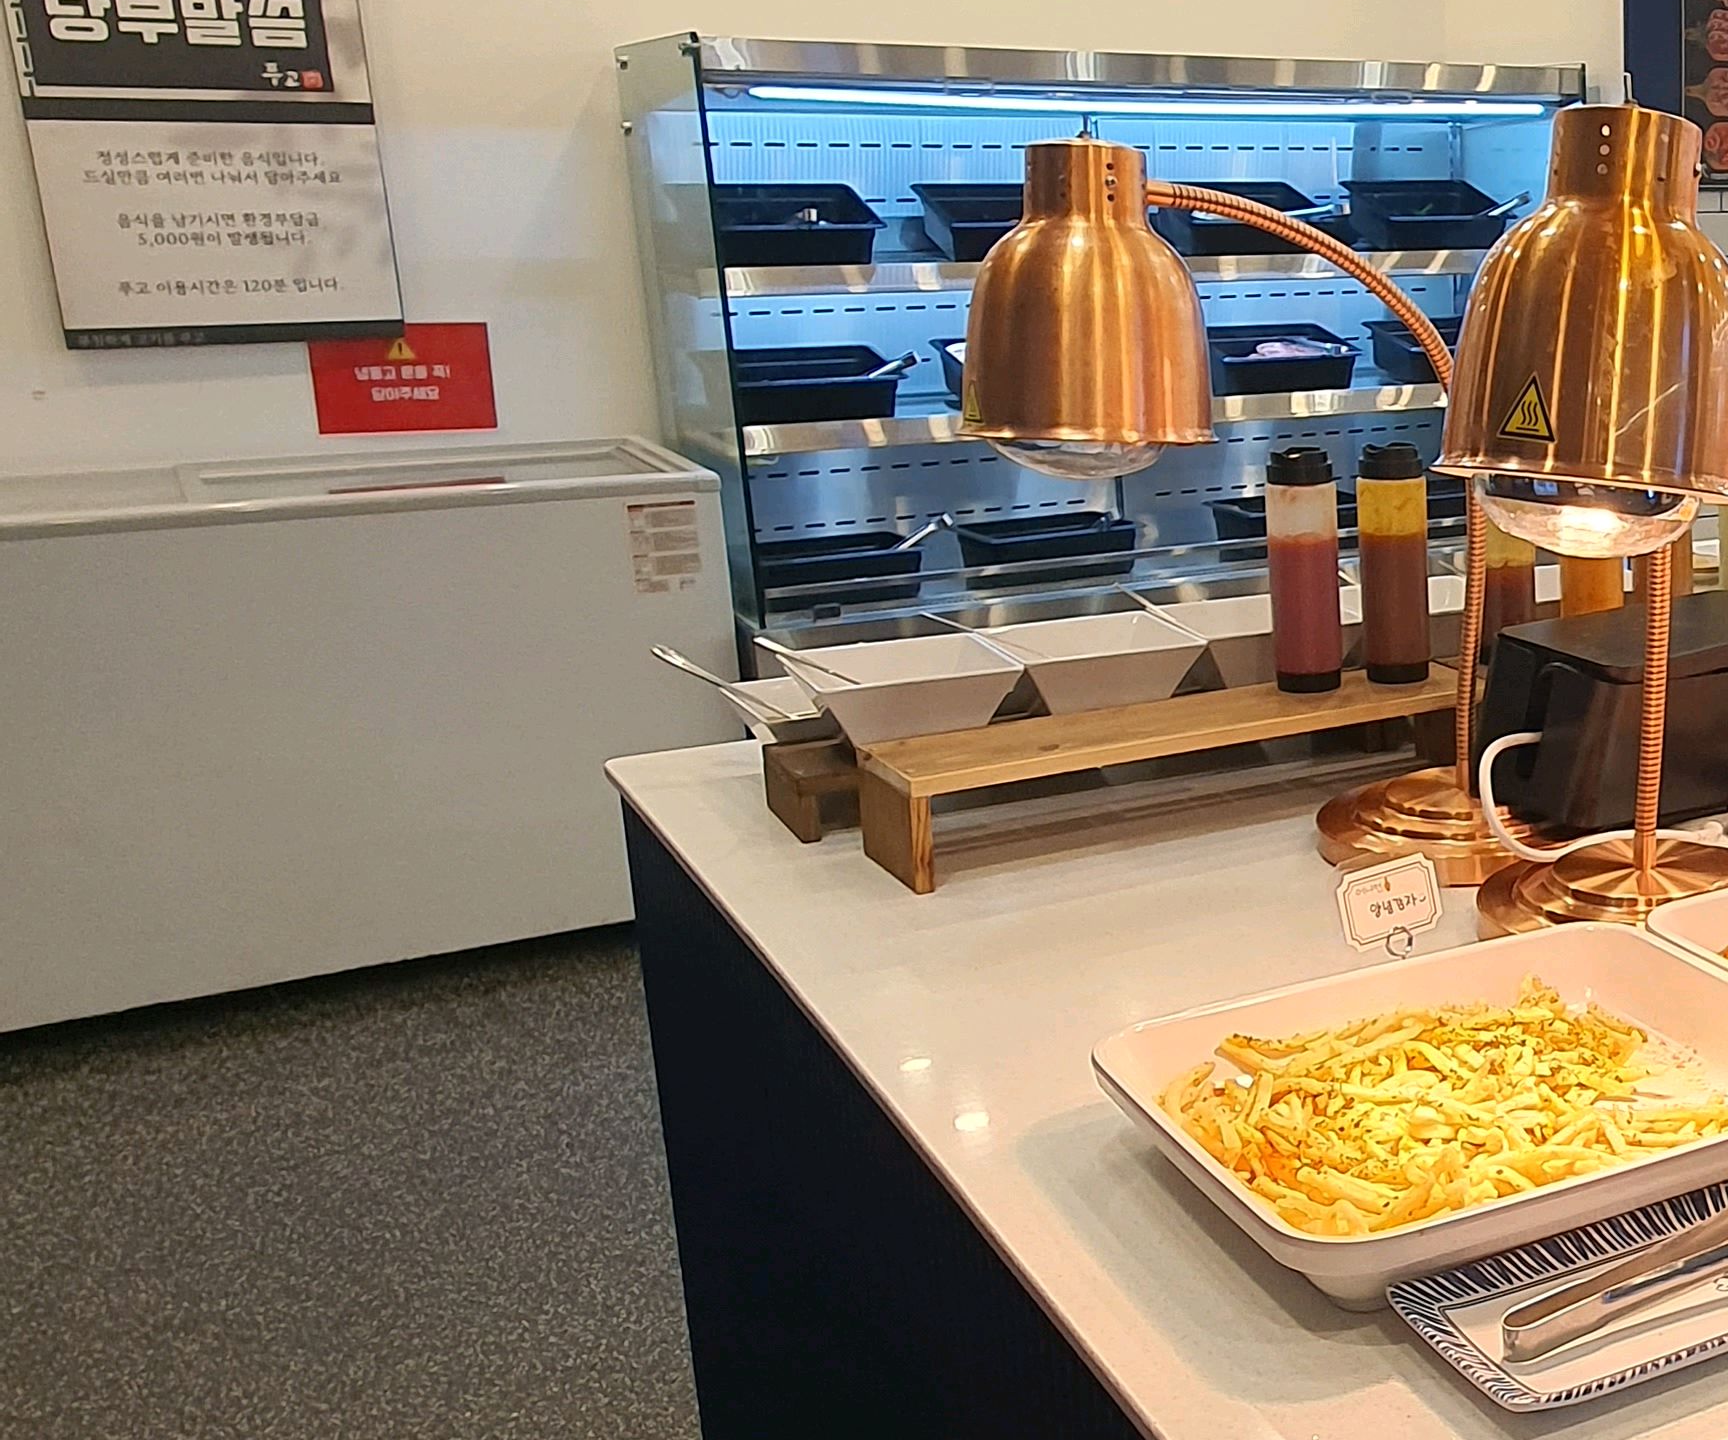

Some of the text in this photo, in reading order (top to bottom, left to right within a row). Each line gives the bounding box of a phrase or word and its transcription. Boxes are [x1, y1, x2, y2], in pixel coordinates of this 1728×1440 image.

[261, 62, 300, 87] 푸고
[97, 150, 181, 166] 정성스럽게
[187, 151, 234, 166] 준비한
[83, 170, 343, 185] 드실만큼 여러번 나눠서 담아주세요
[117, 212, 164, 229] 음식을
[171, 212, 236, 228] 남기시면
[138, 231, 222, 247] 5,000원이
[118, 280, 151, 296] 푸고
[156, 279, 237, 296] 이용시간은
[243, 279, 288, 294] 120분
